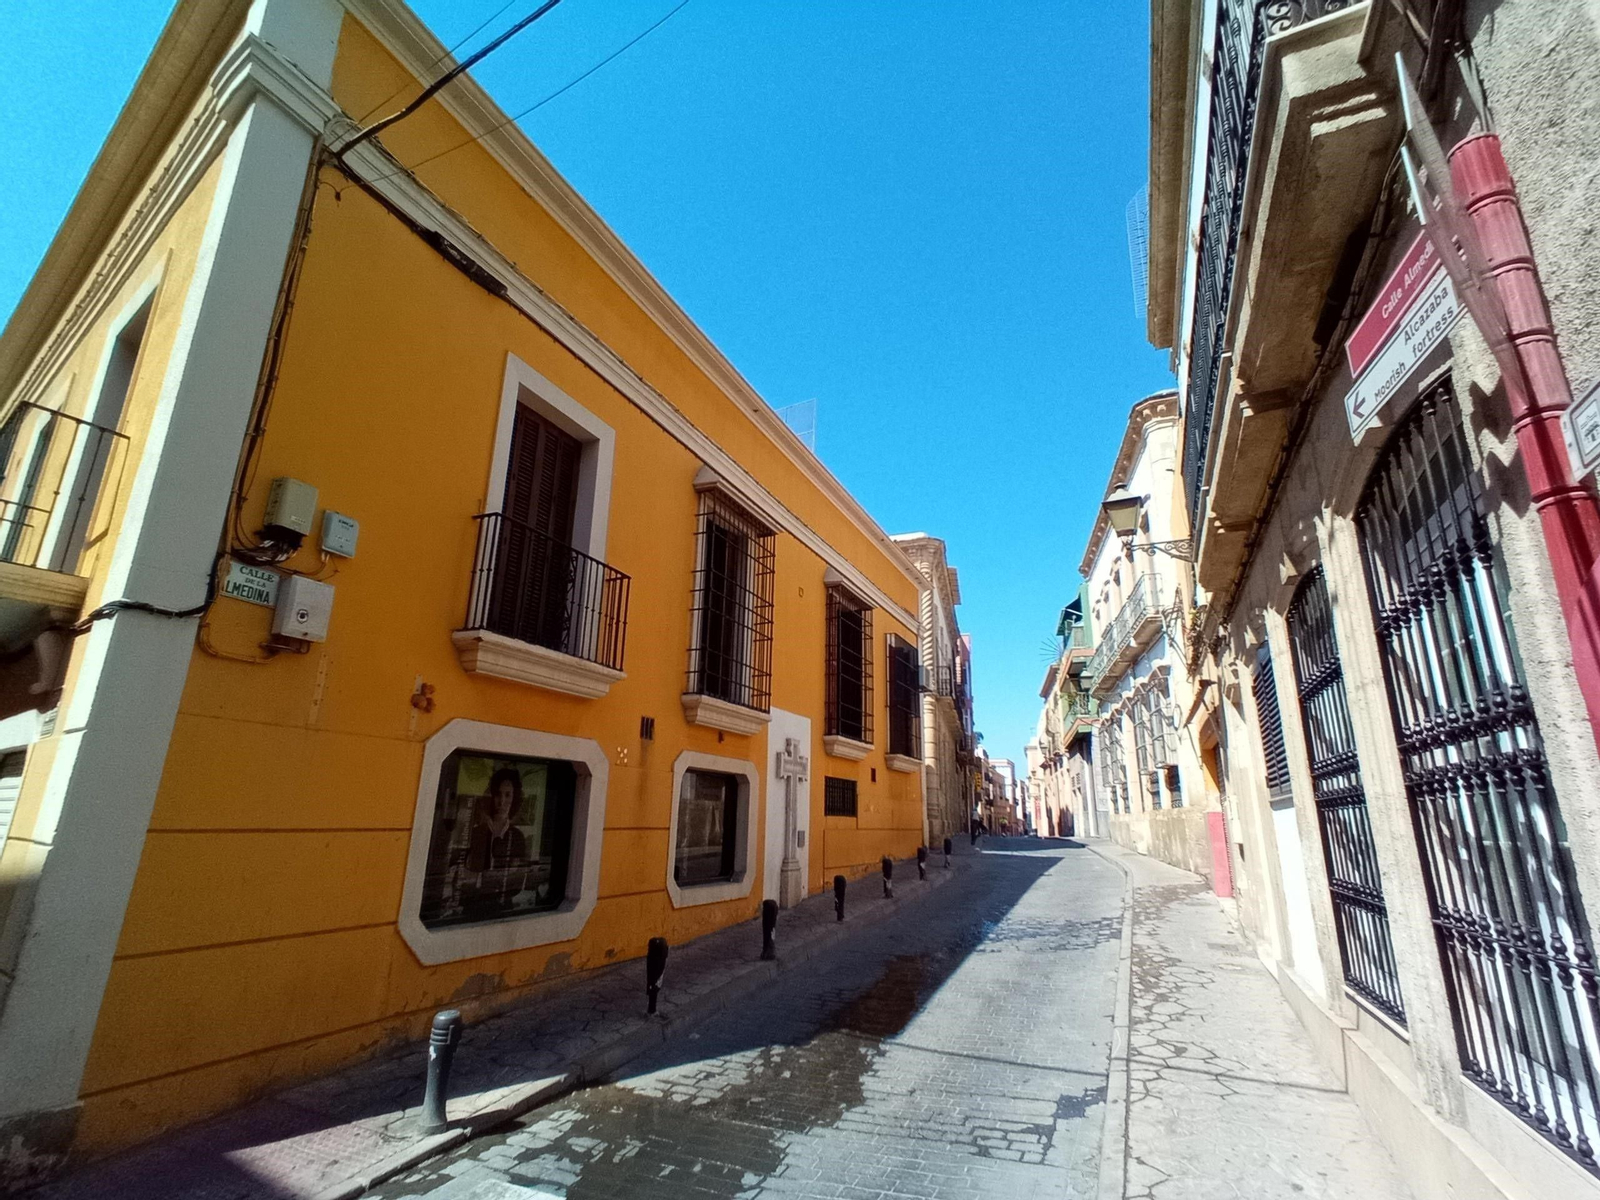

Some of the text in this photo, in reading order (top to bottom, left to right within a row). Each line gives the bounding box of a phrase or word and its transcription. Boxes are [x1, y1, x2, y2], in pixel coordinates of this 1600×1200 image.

[1382, 240, 1435, 319] Calle Almedi
[1403, 286, 1448, 345] Alcazaba
[1374, 306, 1454, 402] Moorish fortress
[224, 580, 270, 604] LMEDINA
[240, 566, 275, 583] CALLE
[245, 577, 256, 585] DE
